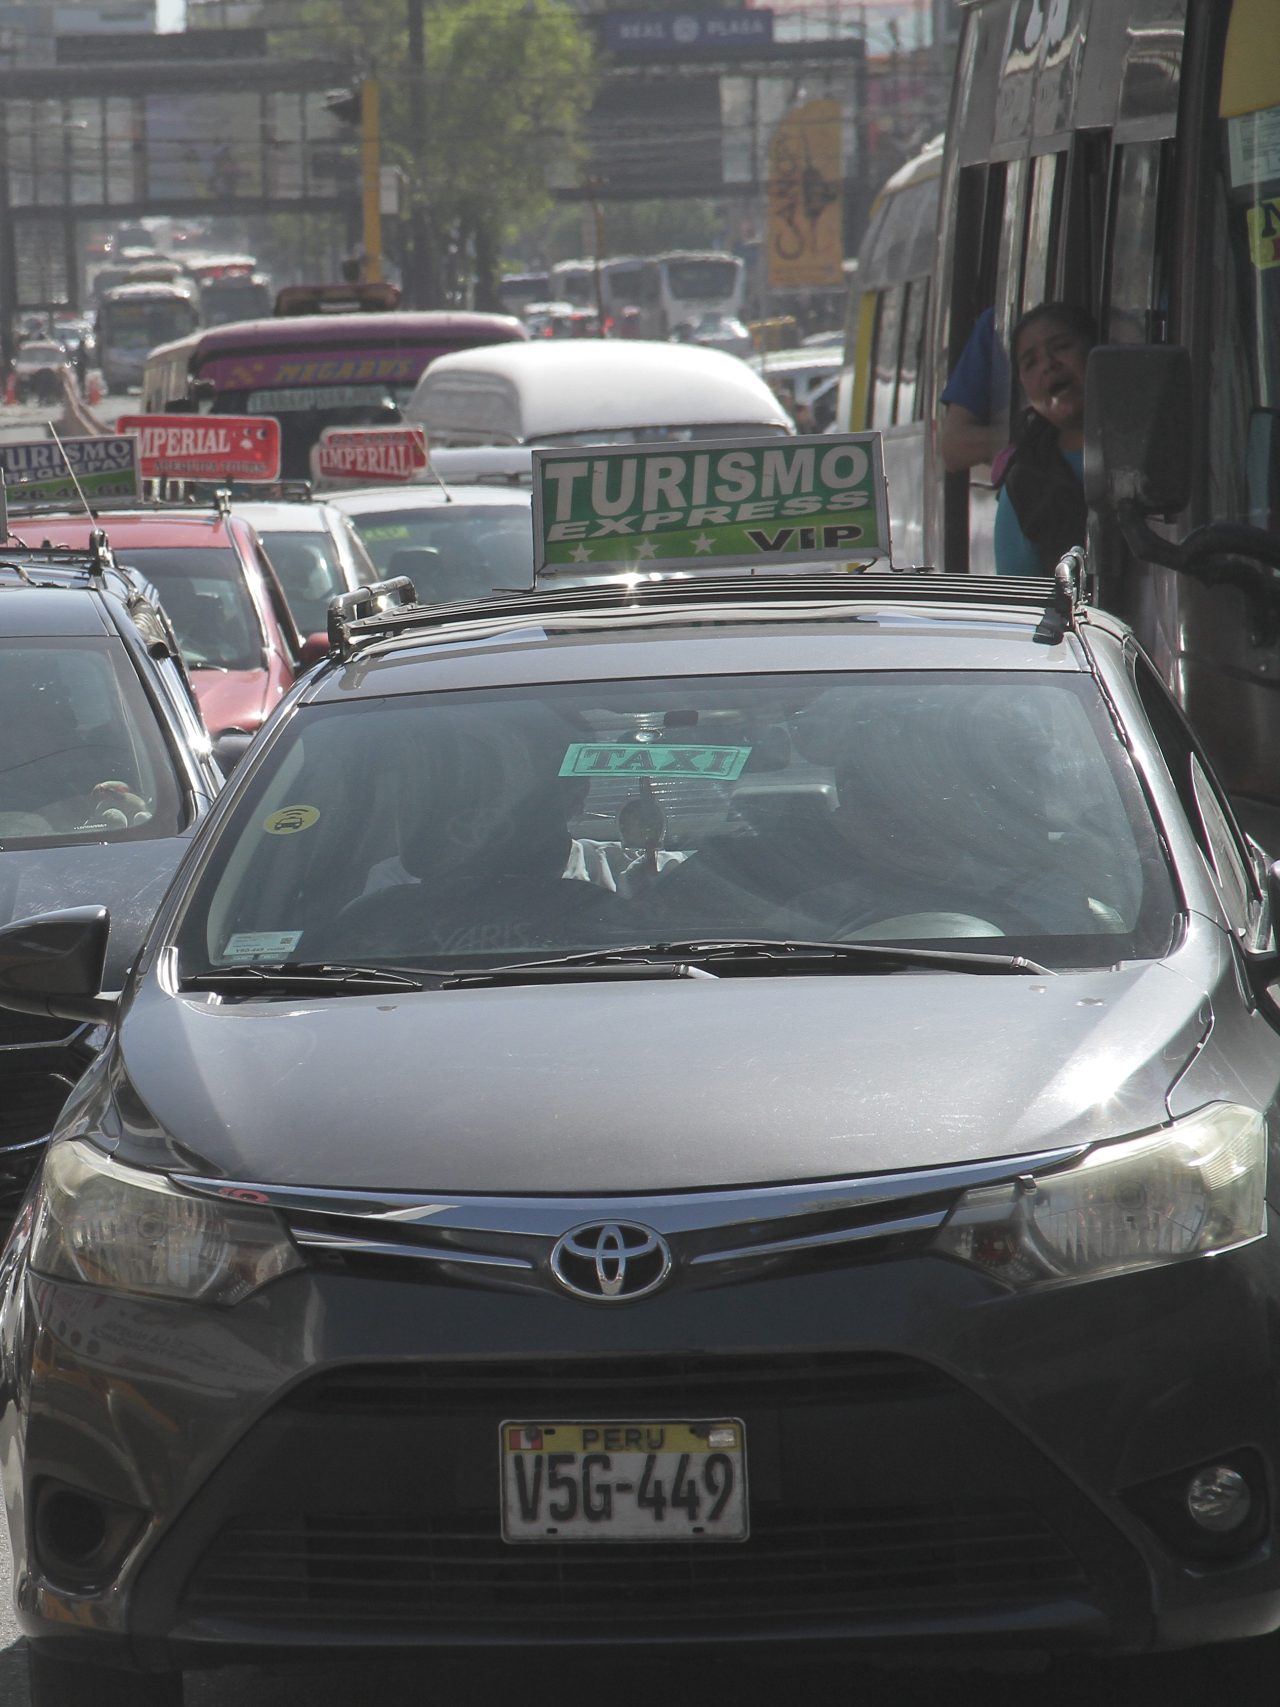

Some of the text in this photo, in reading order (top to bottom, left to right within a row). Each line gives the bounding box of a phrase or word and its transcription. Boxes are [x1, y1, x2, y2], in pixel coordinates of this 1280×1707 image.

[322, 446, 411, 476] IMPERIAL
[545, 445, 870, 522] TURISMO
[547, 490, 870, 542] EXPRESS
[743, 525, 864, 552] VIP
[583, 749, 734, 773] TAXI
[582, 1427, 665, 1451] PERU
[514, 1452, 734, 1523] V5G-449
